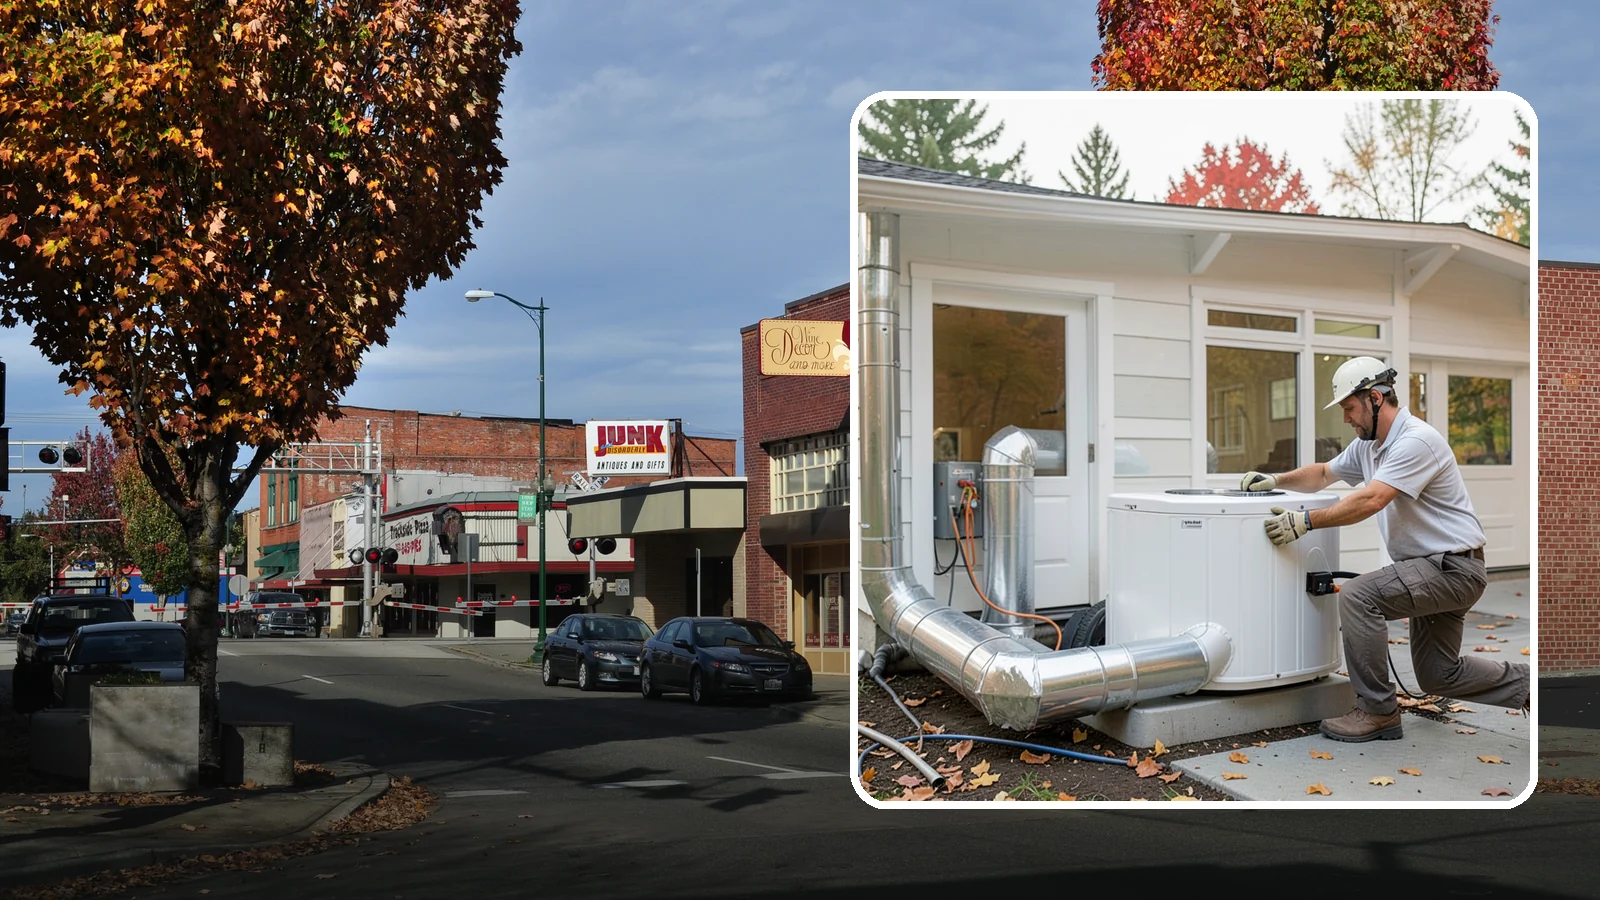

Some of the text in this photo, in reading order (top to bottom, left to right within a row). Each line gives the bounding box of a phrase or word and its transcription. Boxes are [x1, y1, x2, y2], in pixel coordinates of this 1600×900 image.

[765, 327, 830, 365] Decor
[595, 425, 666, 457] JUNK
[607, 446, 645, 454] DISORDERLY
[597, 460, 665, 470] ANTIQUES AND GIFTS
[390, 519, 429, 540] Trackside Pizza
